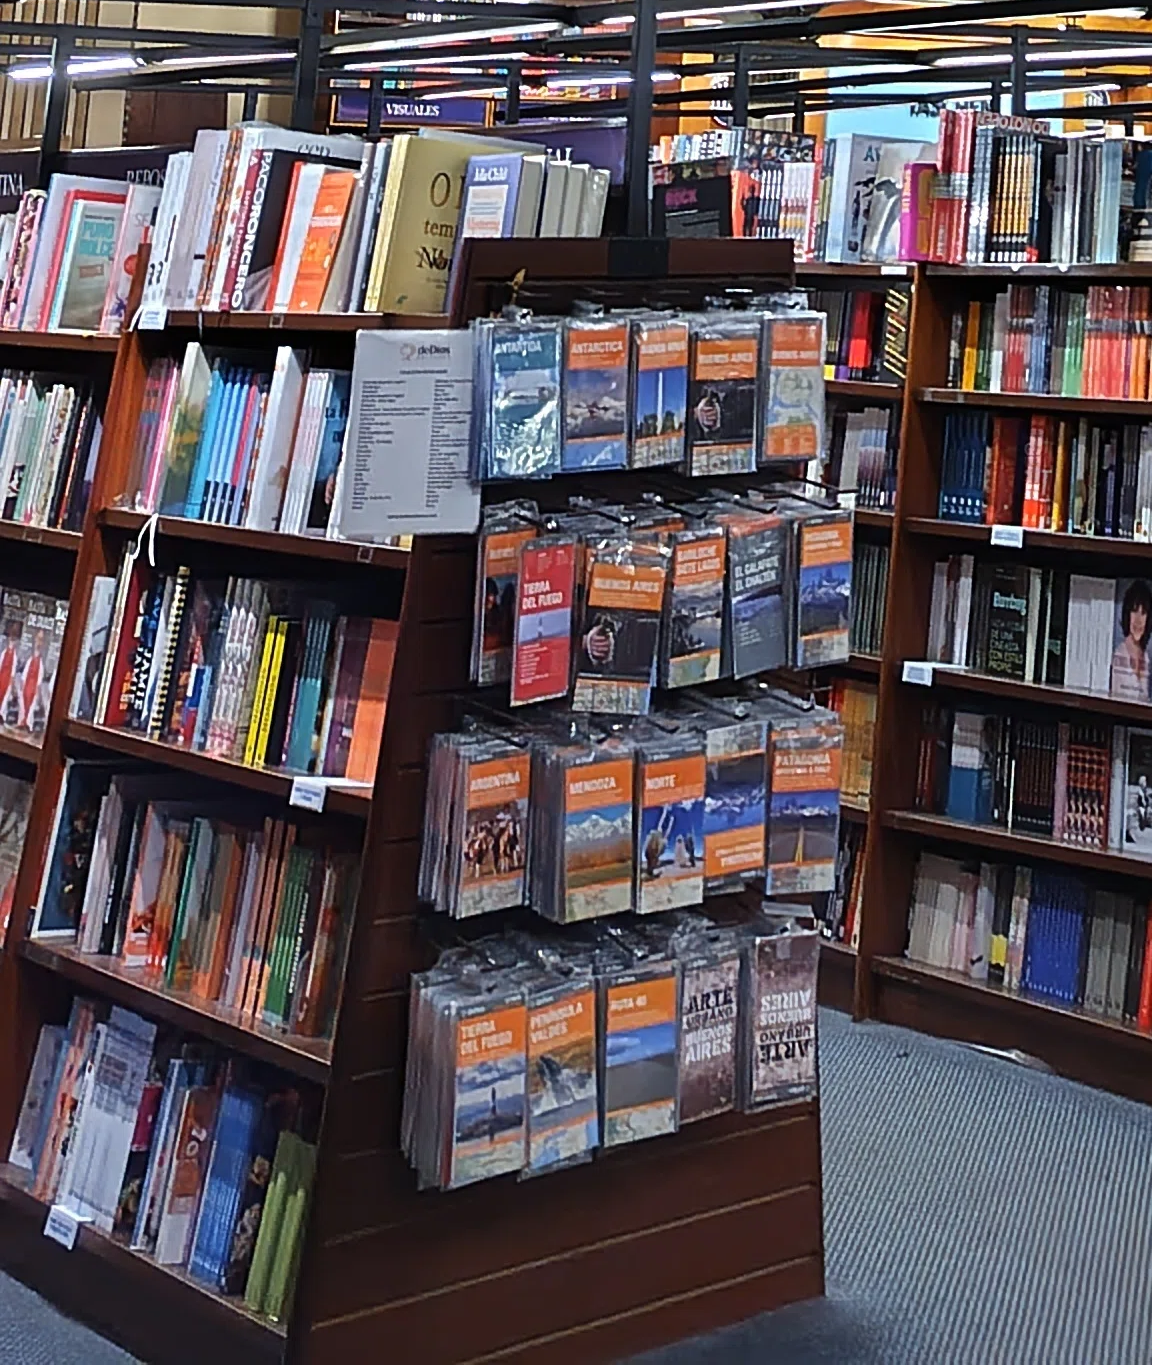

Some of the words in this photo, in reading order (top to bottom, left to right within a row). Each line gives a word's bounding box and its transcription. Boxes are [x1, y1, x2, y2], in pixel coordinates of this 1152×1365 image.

[386, 102, 440, 117] VISUALES
[571, 340, 623, 355] ANTARCTICA
[470, 770, 521, 792] ARGENTINA
[569, 776, 617, 794] MENDOZA
[644, 773, 677, 790] NORTE
[688, 986, 734, 1013] ARTE
[760, 988, 812, 1013] AIRES
[461, 1020, 496, 1039] TIERRA
[685, 1037, 732, 1064] AIRES
[759, 1038, 814, 1064] ARTE
